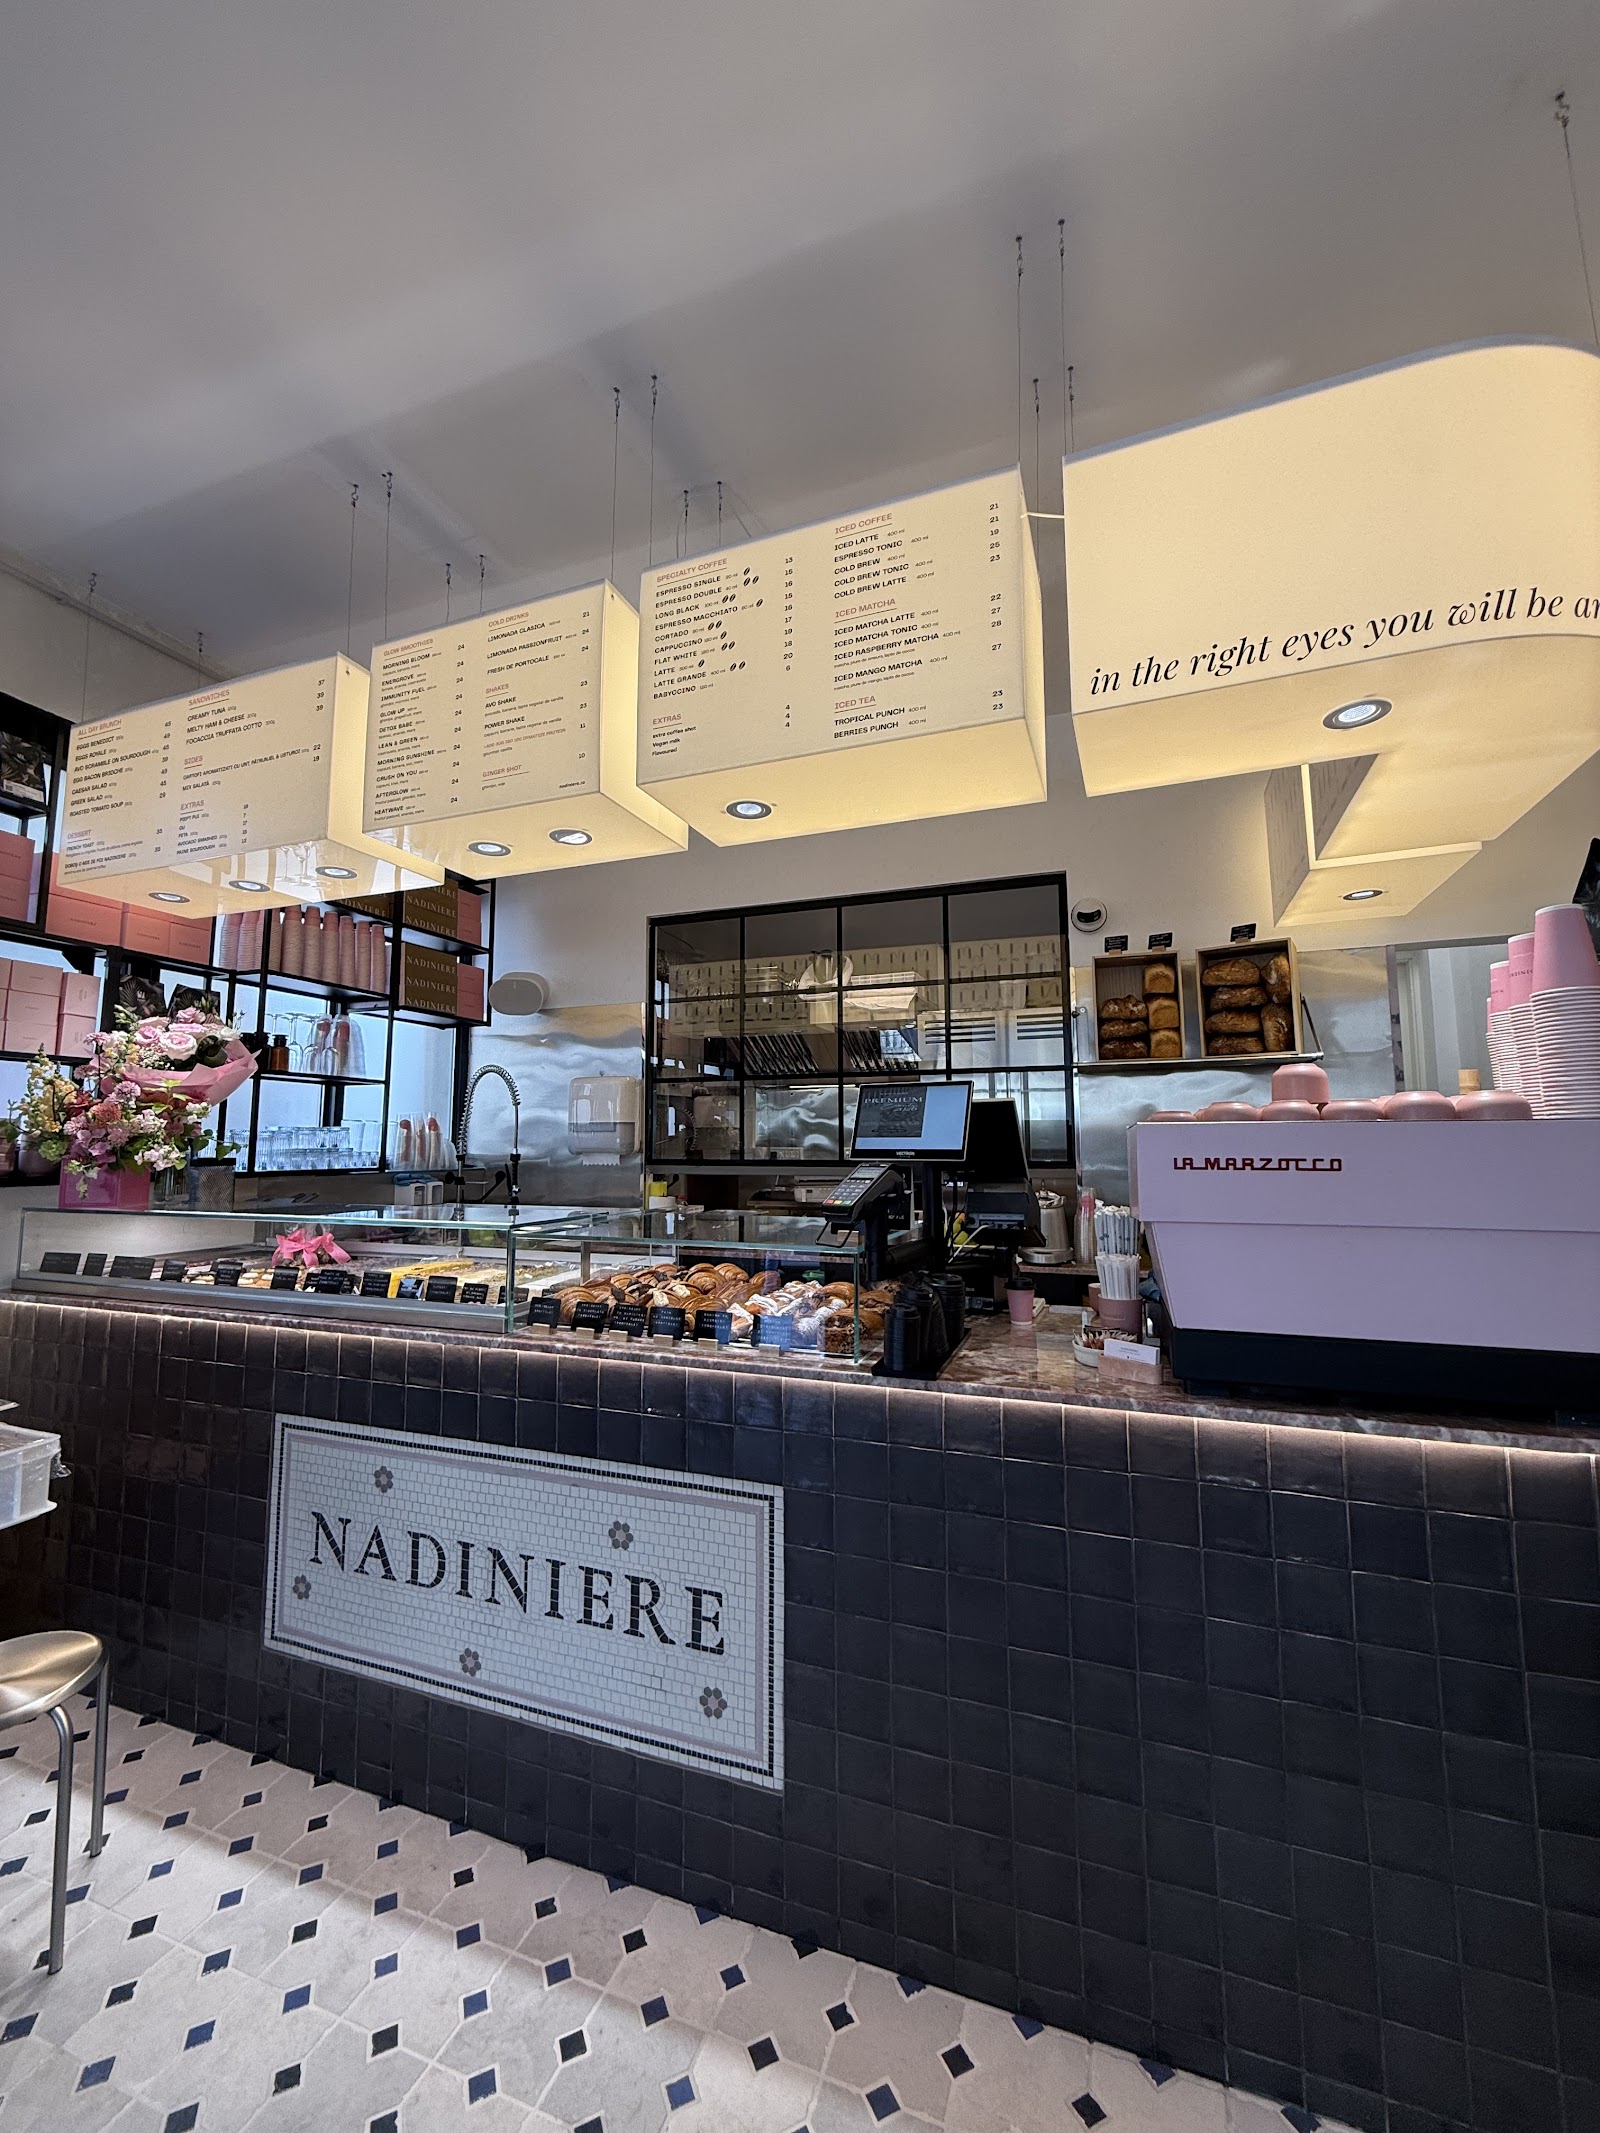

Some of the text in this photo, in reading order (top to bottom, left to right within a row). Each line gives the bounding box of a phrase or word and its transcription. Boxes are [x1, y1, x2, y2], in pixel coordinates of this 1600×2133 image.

[989, 502, 998, 510] 21
[834, 512, 892, 534] ICED COFFEE
[989, 515, 999, 523] 21
[990, 528, 999, 536] 19
[834, 533, 878, 551] ICED LATTE
[989, 541, 1000, 549] 25
[834, 539, 902, 563] ESPRESSO TONIC
[989, 553, 1000, 562] 23
[656, 557, 727, 583] SPECIALTY COFFEE
[833, 557, 880, 575] COLD BREW
[833, 562, 909, 587] COLD BREW TONIC
[655, 575, 720, 597] ESPRESSO SINGLE
[833, 576, 906, 599] COLD BREW LATTE
[655, 586, 722, 608] ESPRESSO DOUBLE
[990, 593, 1001, 601] 22
[654, 603, 699, 620] LONG BLACK
[835, 597, 896, 618] ICED MATCHA
[990, 606, 1001, 614] 27
[487, 611, 529, 628] COLD DRINKS
[654, 605, 738, 631] ESPRESSO MACCHIATO
[834, 612, 915, 636] ICED MATCHA LATTE
[990, 619, 1002, 628] 28
[487, 622, 545, 642] LIMONADA CLASICA
[654, 628, 689, 642] CORTADO
[834, 624, 918, 648] ICED MATCHA TONIC
[486, 634, 562, 659] LIMONADA PASSIONFRUIT
[654, 637, 703, 654] CAPPUCCINO
[834, 632, 939, 661] ICED RASPBERRY MATCHA
[991, 642, 1002, 651] 27
[1090, 668, 1121, 695] in
[1132, 657, 1177, 687] the
[1190, 636, 1270, 677] right
[1282, 624, 1354, 660] eyes
[1365, 606, 1434, 648] you
[1447, 588, 1518, 626] will
[1527, 587, 1563, 618] be
[382, 652, 430, 670] MORNING BLOOM
[486, 666, 505, 674] FRESH
[514, 654, 549, 668] PORTOCALE
[654, 650, 697, 665] FLAT WHITE
[653, 666, 675, 676] LATTE
[834, 658, 922, 682] ICED MANGO MATCHA
[381, 673, 414, 686] ENERGROVE
[485, 682, 509, 694] SHAKES
[653, 671, 706, 688] LATTE GRANDE
[380, 686, 425, 701] IMMUNITY FUEL
[653, 684, 696, 699] BABYCCINO
[992, 689, 1003, 697] 23
[484, 696, 516, 708] AVO SHAKE
[834, 694, 876, 710] ICED TEA
[992, 702, 1003, 710] 23
[484, 715, 525, 729] POWER SHAKE
[652, 713, 682, 725] EXTRAS
[834, 706, 905, 726] TROPICAL PUNCH
[833, 720, 898, 738] BERRIES PUNCH
[377, 741, 393, 749] LEAN
[398, 736, 418, 745] GREEN
[375, 774, 395, 782] CRUSH
[482, 764, 522, 777] GINGER SHOT
[375, 788, 408, 798] AFTERGLOW
[374, 805, 403, 815] HEATWAVE
[406, 894, 456, 918] NADINIERE
[406, 915, 456, 937] NADINIERE
[406, 955, 456, 975] NADINIERE
[406, 976, 456, 994] NADINIERE
[406, 996, 456, 1014] NADINIERE
[864, 1096, 923, 1104] PREMIUM
[1174, 1157, 1342, 1171] LA MARZOCCO
[310, 1511, 725, 1656] NADINIERE
